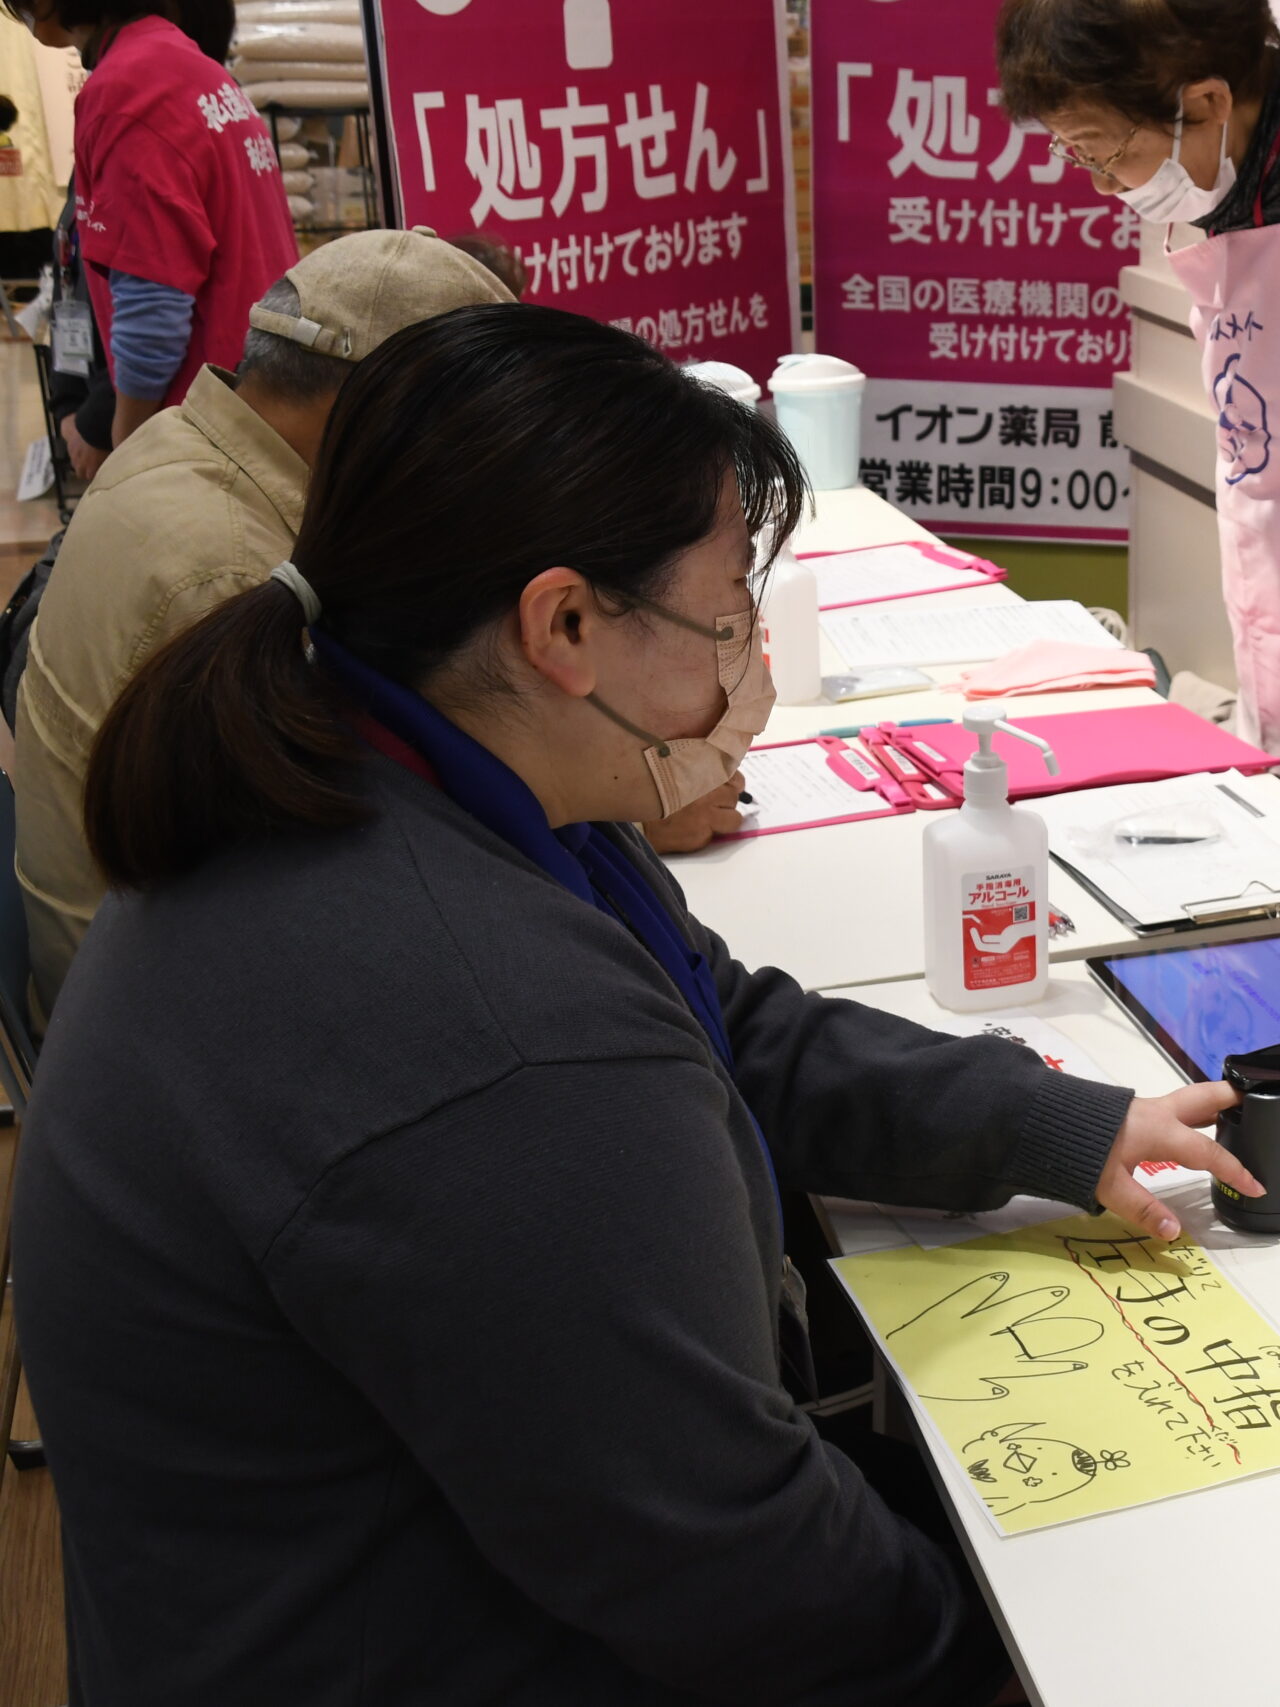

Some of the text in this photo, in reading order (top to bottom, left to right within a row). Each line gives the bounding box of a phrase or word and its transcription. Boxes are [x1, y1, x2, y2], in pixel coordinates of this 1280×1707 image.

[413, 82, 770, 229] 「処方せん」
[841, 274, 1131, 320] 全国の医療機関の
[929, 322, 1131, 367] 受け付けており
[876, 403, 1080, 449] イオン薬局
[968, 886, 1029, 905] アルコール
